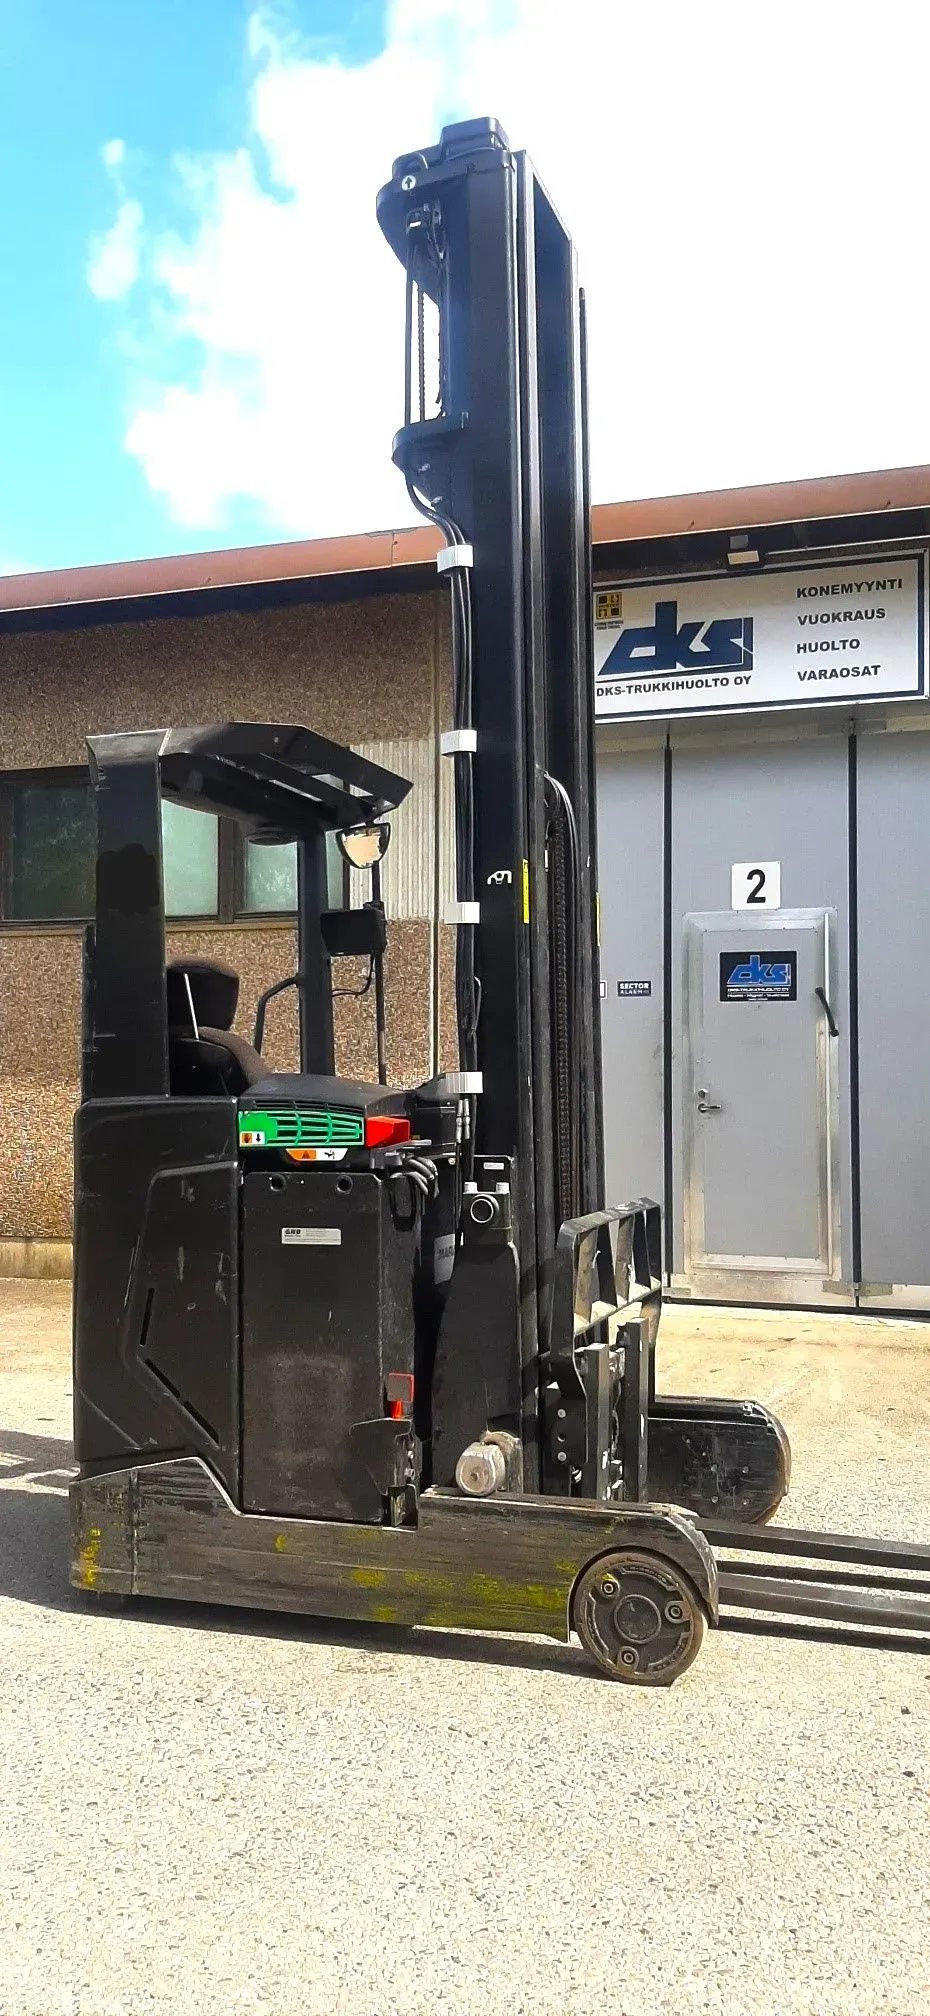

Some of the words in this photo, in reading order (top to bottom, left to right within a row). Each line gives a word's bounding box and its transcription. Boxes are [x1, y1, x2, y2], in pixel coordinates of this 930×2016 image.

[796, 579, 903, 598] KONEMYYNTI
[797, 608, 886, 626] VUOKRAUS
[796, 639, 860, 654] HUOLTO
[797, 665, 881, 682] VARAOSAT
[596, 677, 730, 697] DKS-TRUKKIHUOLTO
[733, 675, 752, 686] OY
[746, 868, 767, 904] 2
[619, 982, 650, 990] SECTOR
